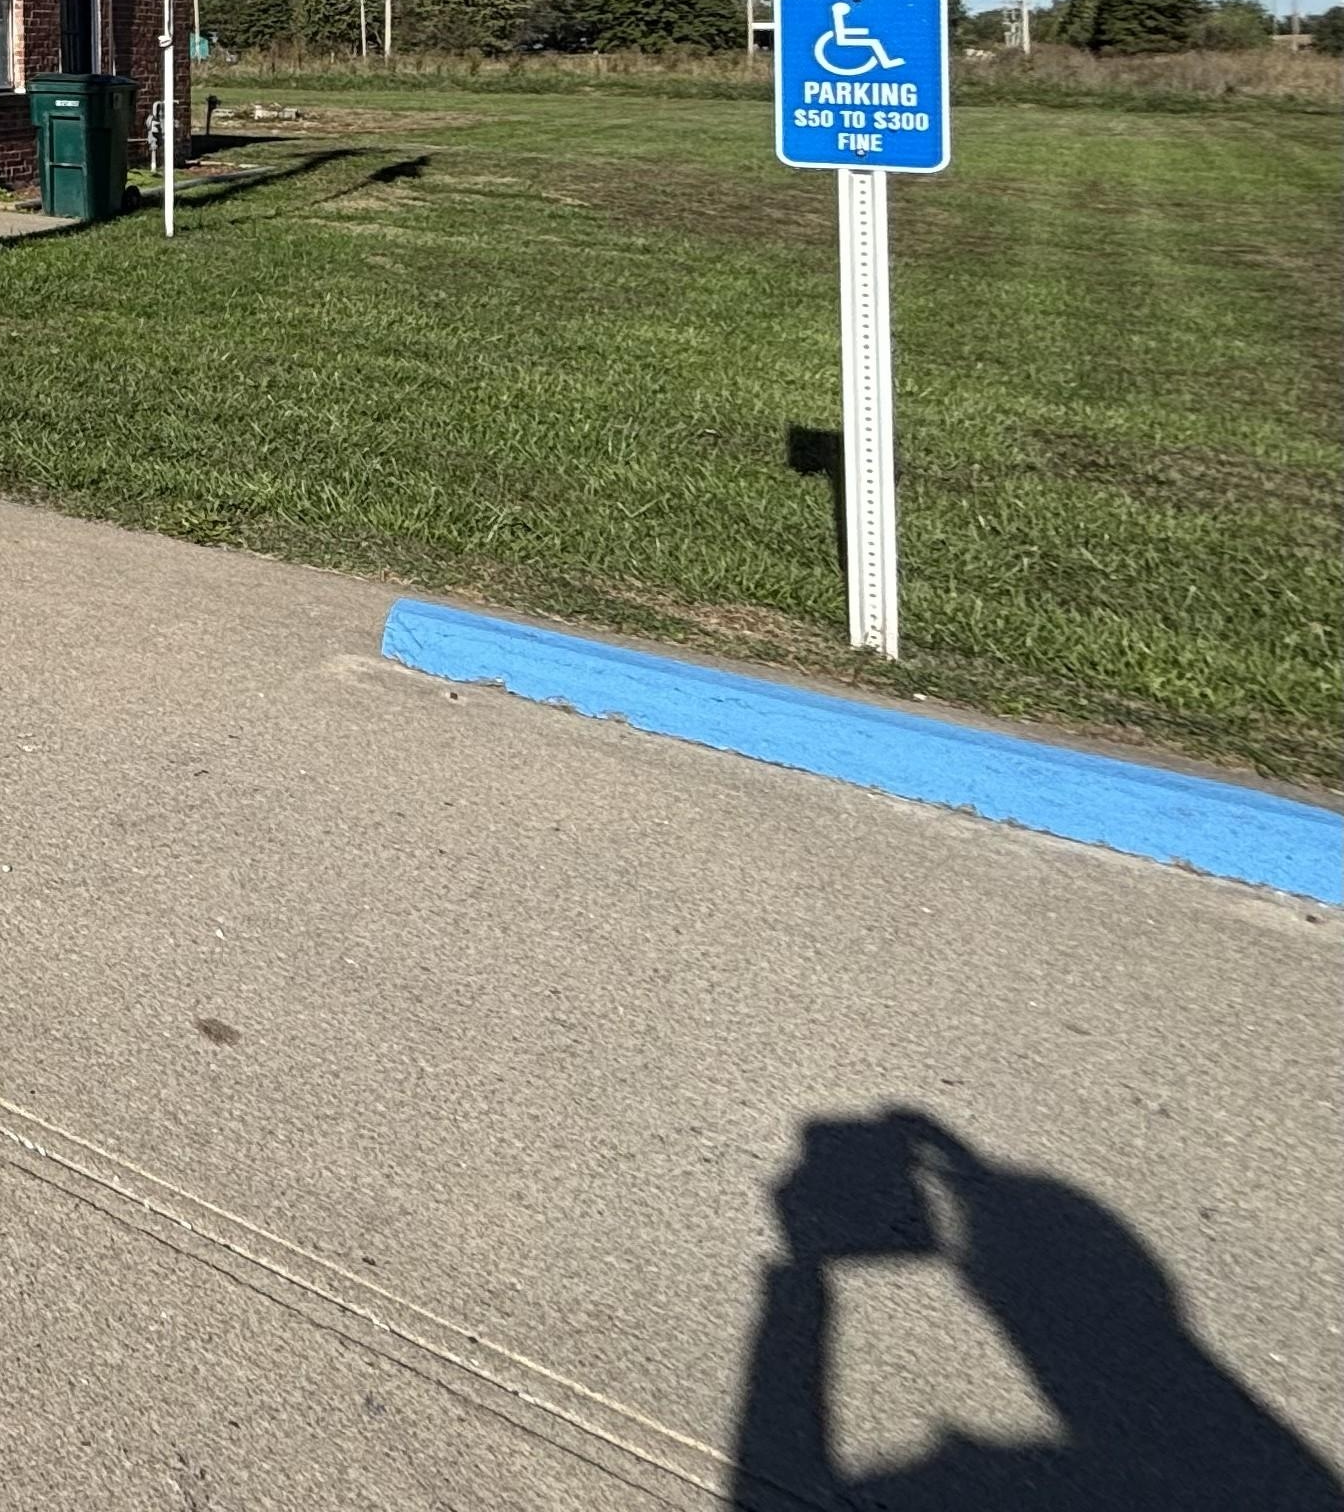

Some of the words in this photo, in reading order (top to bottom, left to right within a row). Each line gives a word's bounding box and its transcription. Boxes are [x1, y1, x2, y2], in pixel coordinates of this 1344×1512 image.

[804, 81, 918, 107] PARKING
[794, 108, 834, 128] $50
[839, 110, 866, 129] TO
[873, 111, 930, 132] $300
[837, 132, 884, 153] FINE
